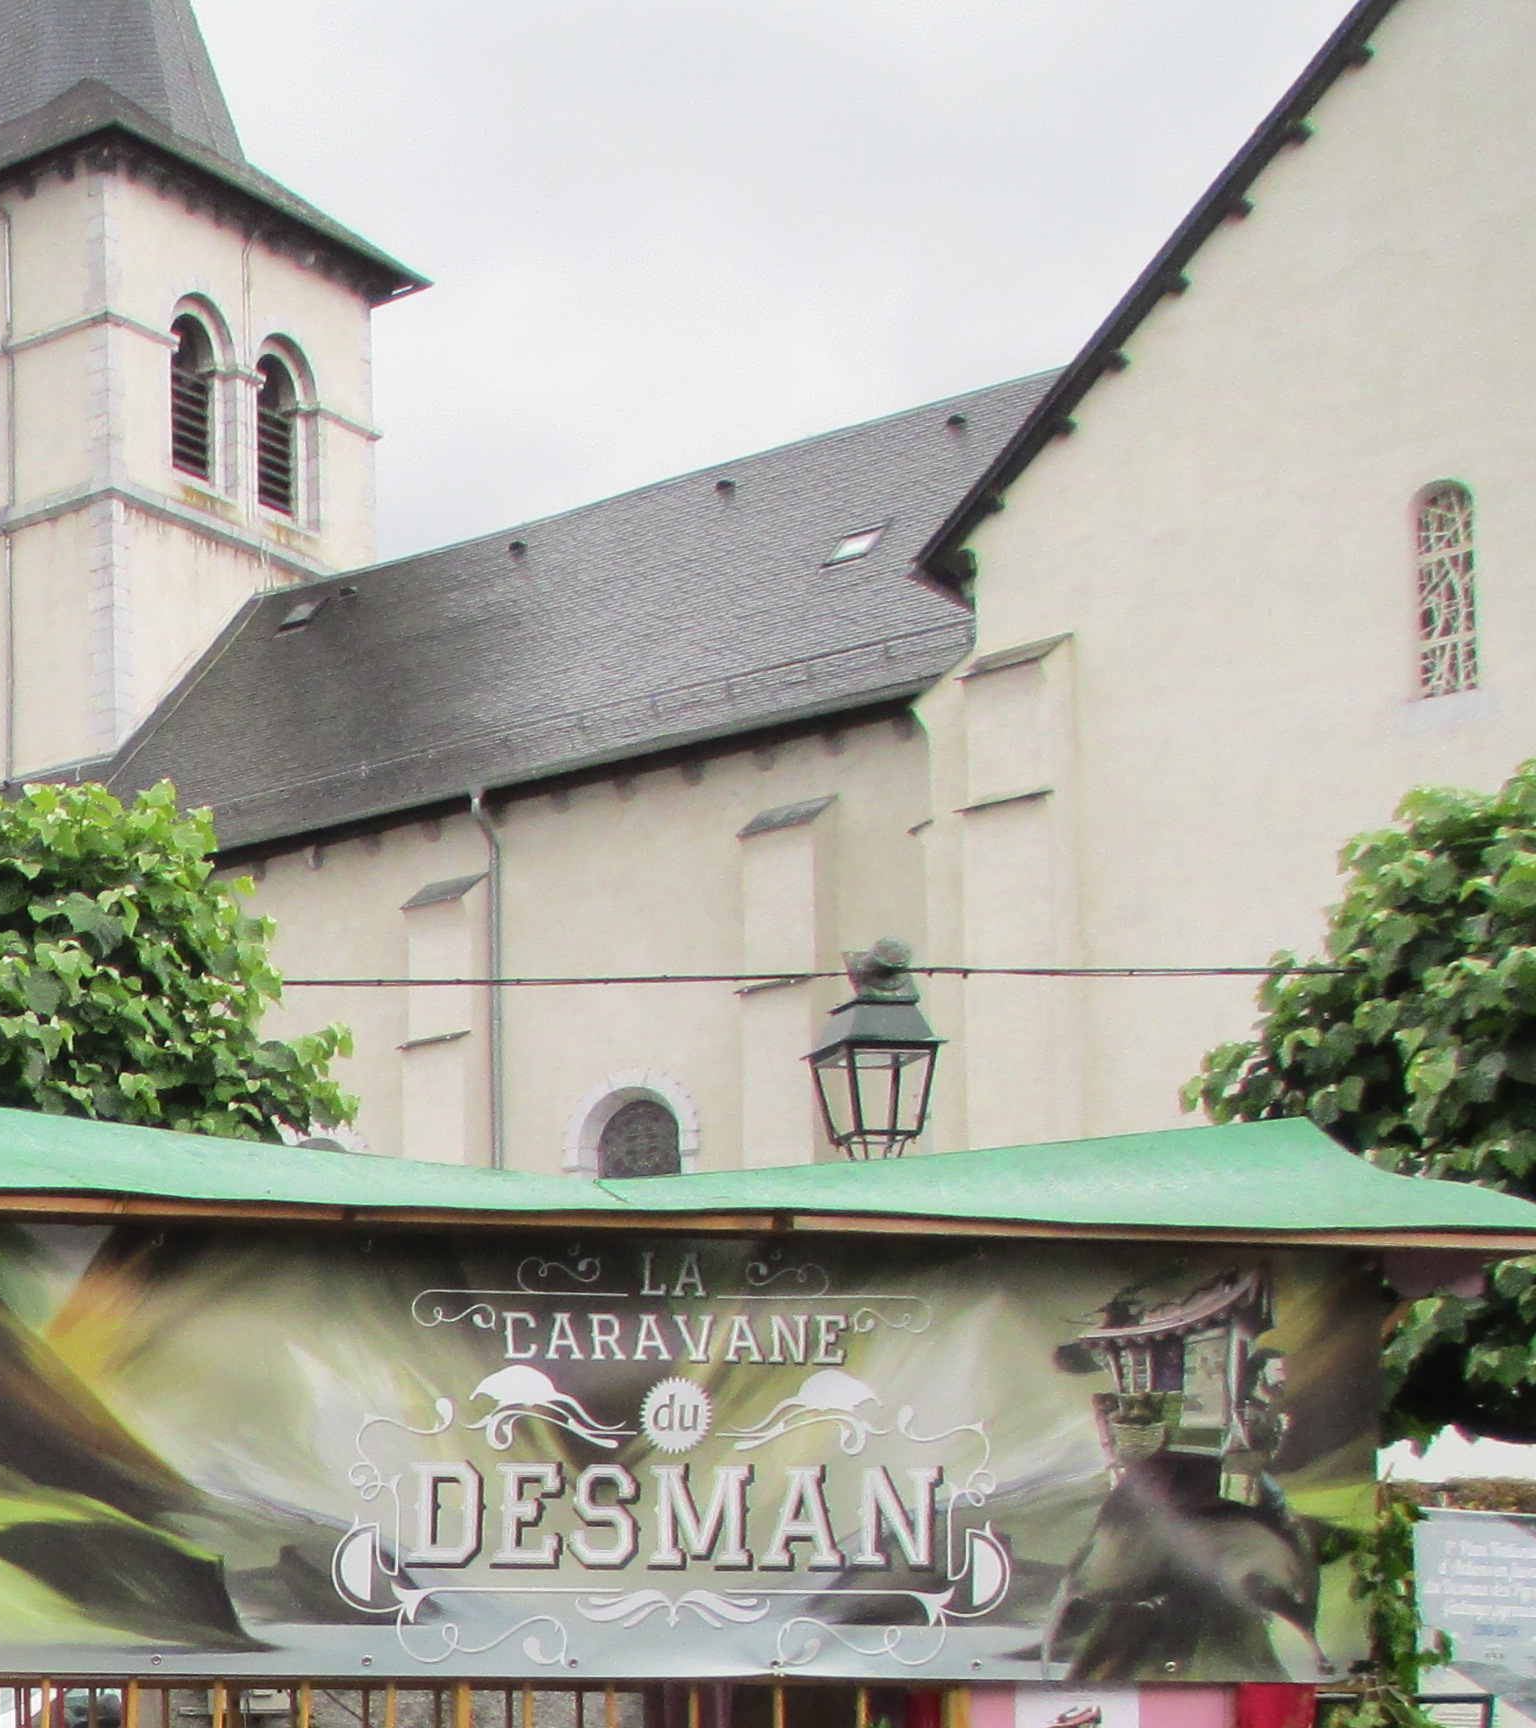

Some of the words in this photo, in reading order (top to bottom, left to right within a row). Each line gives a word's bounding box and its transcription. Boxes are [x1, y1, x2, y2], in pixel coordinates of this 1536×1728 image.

[640, 1251, 707, 1299] LA
[502, 1310, 851, 1366] CARAVANE
[651, 1393, 701, 1434] du
[404, 1459, 944, 1571] DESMAN
